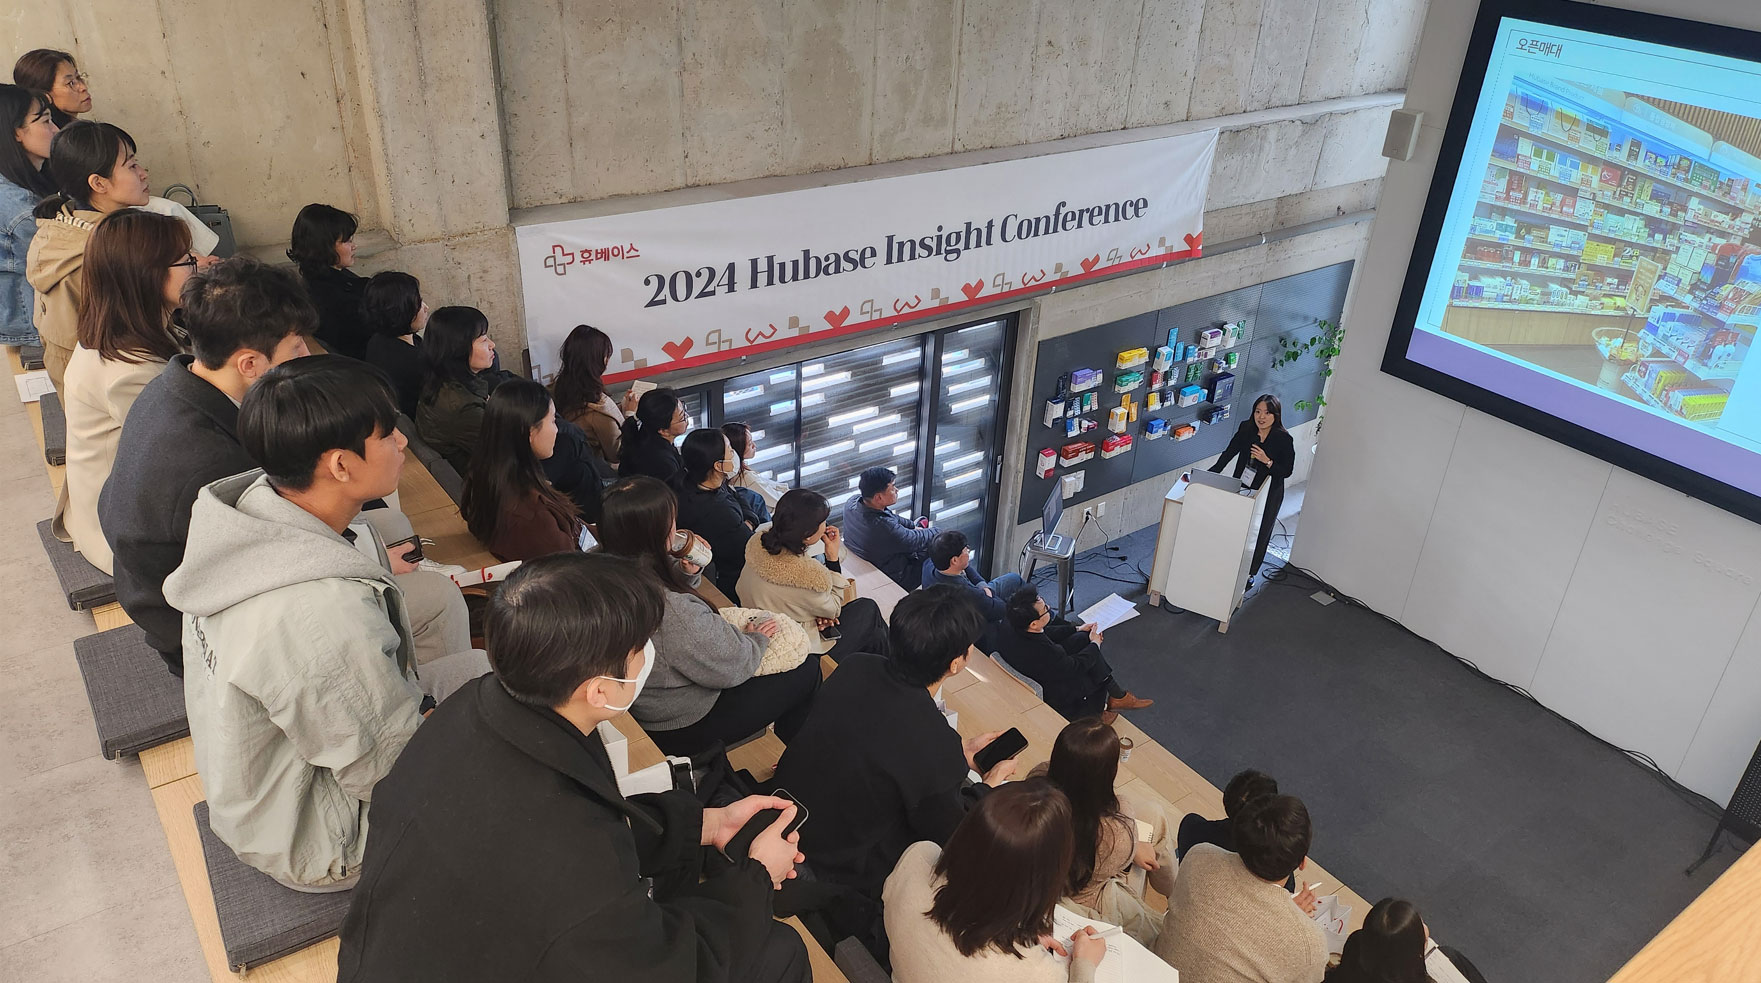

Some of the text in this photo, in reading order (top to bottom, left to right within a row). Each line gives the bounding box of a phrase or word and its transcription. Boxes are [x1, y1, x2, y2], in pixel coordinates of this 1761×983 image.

[1516, 38, 1563, 59] 오픈매대
[579, 243, 641, 266] 휴베이스
[643, 197, 1149, 308] 2024 Hubase Insight Conference
